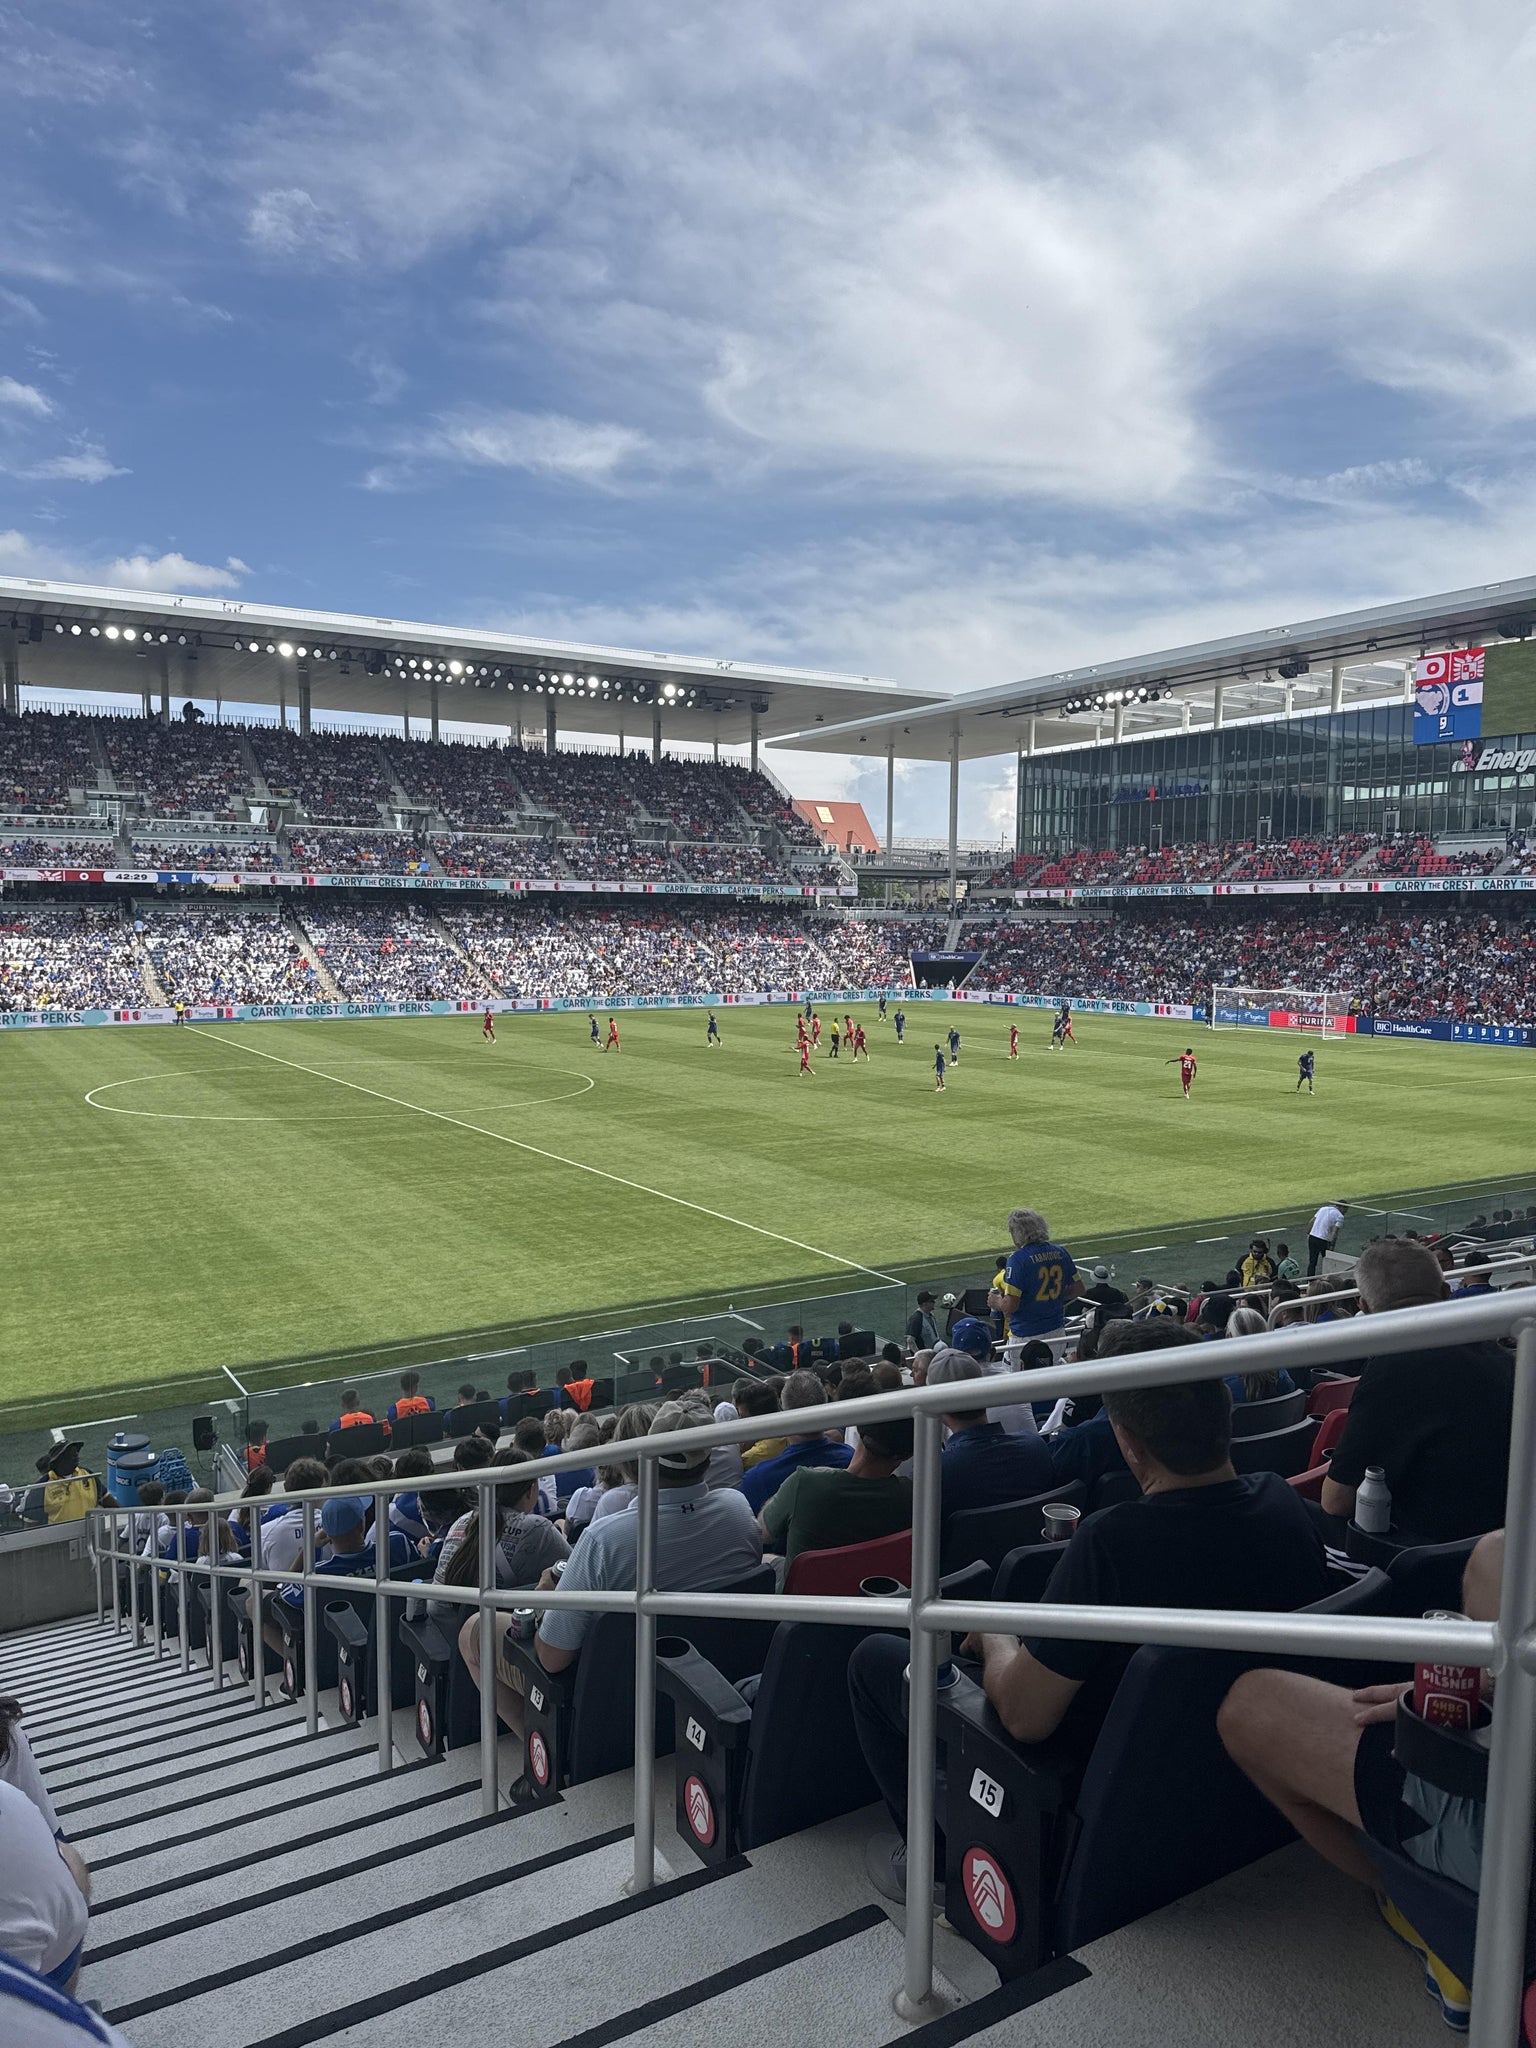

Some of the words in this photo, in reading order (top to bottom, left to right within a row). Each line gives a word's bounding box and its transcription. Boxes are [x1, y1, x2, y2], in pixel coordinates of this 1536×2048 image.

[1457, 688, 1469, 702] 1
[115, 873, 148, 882] 42:29
[170, 873, 180, 882] 1
[331, 877, 363, 886] CARRY
[378, 878, 410, 887] CREST.
[414, 879, 444, 888] CARRY
[459, 880, 490, 889] PERKS.
[664, 885, 689, 893] CARRY
[728, 886, 750, 894] CARRY
[1081, 889, 1102, 897] CARRY
[1136, 887, 1159, 896] CARRY
[1395, 881, 1426, 891] CARRY
[1442, 881, 1477, 890] CREST.
[1482, 880, 1518, 889] CARRY
[1520, 880, 1534, 888] THE
[562, 998, 591, 1008] CARRY
[605, 998, 634, 1007] CREST.
[637, 996, 664, 1006] CARRY
[677, 995, 705, 1005] PERKS.
[808, 991, 831, 1001] CARRY
[843, 991, 865, 1000] CREST.
[868, 990, 891, 999] CARRY
[904, 990, 933, 999] PERKS.
[251, 1006, 288, 1018] CARRY
[290, 1007, 304, 1015] THE
[305, 1005, 342, 1015] CREST.
[347, 1003, 381, 1015] CARRY
[384, 1004, 396, 1012] THE
[399, 1002, 433, 1012] PERKS.
[1022, 995, 1044, 1006] CARRY
[1077, 999, 1100, 1010] CARRY
[1101, 1002, 1110, 1010] THE
[1111, 1001, 1137, 1013] PERKS.
[0, 1014, 18, 1025] RY
[22, 1015, 38, 1023] THE
[41, 1012, 84, 1024] PERKS.
[1299, 1015, 1333, 1026] PURINA
[1376, 1022, 1390, 1031] BJC
[1392, 1023, 1432, 1035] HealthCare
[1036, 1264, 1063, 1301] 23
[1433, 1663, 1465, 1678] CITY
[1422, 1669, 1475, 1690] PILSNER
[534, 1689, 541, 1705] 13
[691, 1723, 702, 1744] 14
[978, 1779, 997, 1806] 15
